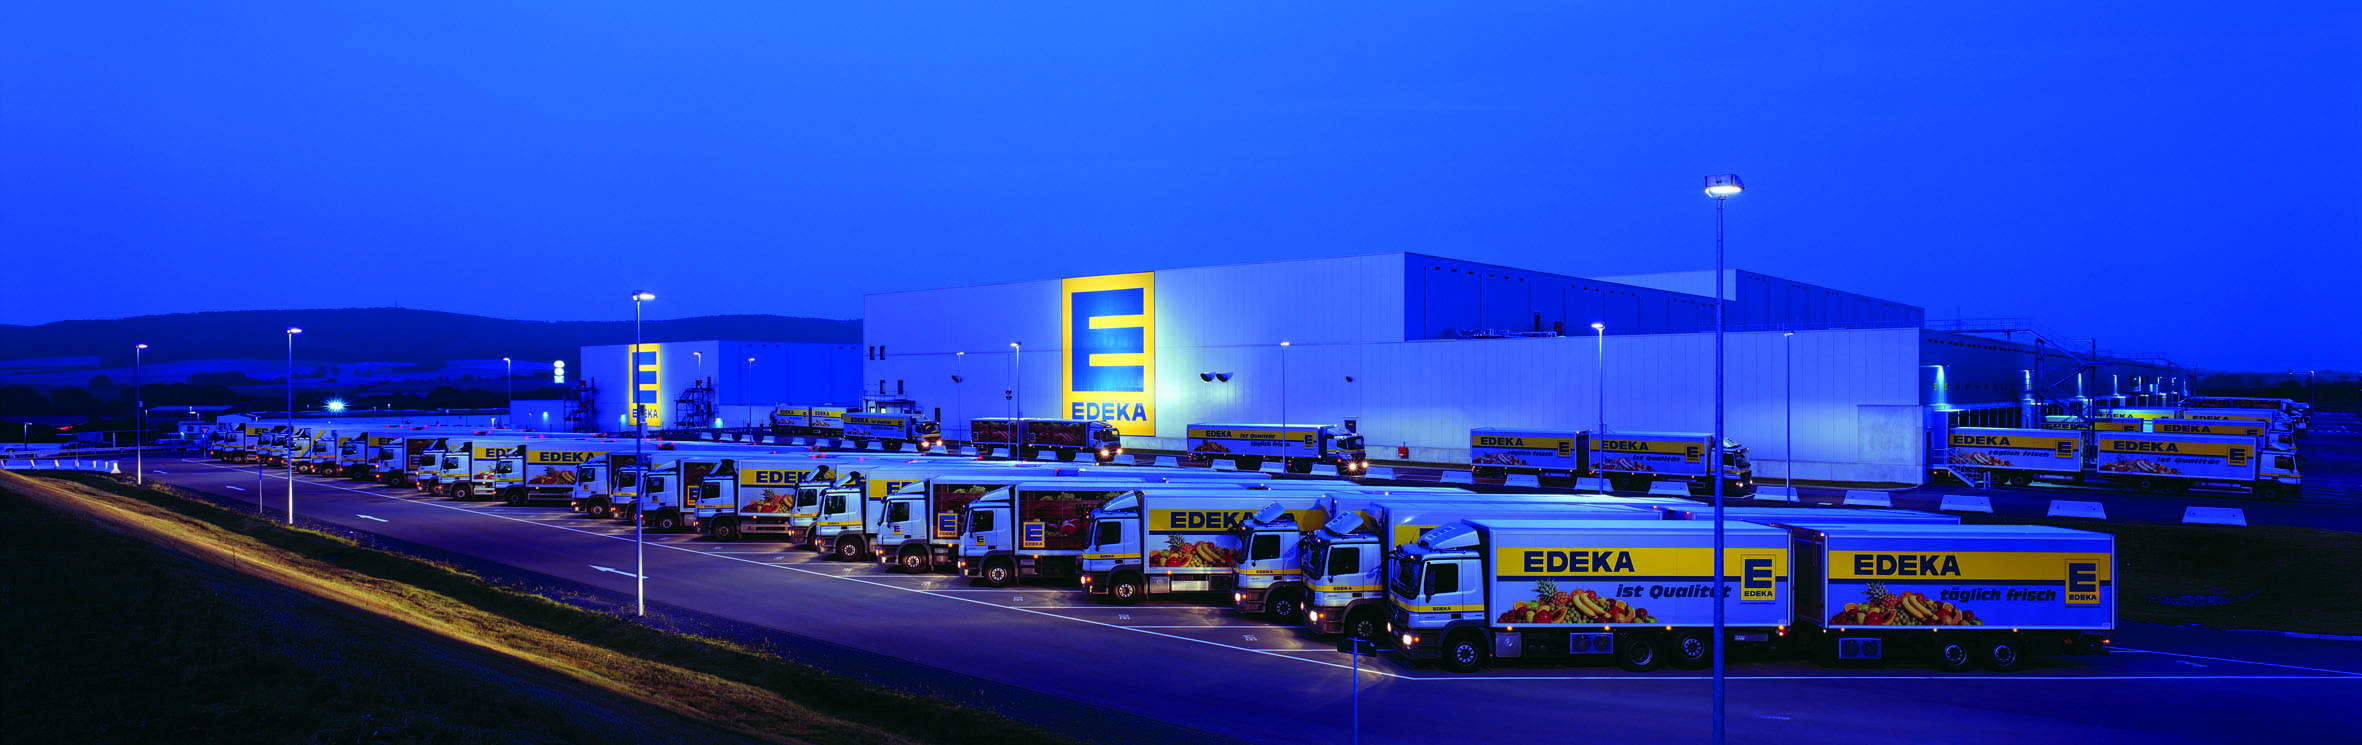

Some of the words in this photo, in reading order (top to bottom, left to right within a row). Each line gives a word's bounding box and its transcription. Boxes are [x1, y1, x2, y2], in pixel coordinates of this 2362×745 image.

[1072, 288, 1144, 391] E
[1072, 402, 1147, 421] EDEKA
[1206, 430, 1232, 438] EDEKA
[2163, 424, 2211, 433] EDEKA
[1480, 437, 1523, 446] EDEKA
[1559, 442, 1570, 452] E
[1602, 440, 1649, 450] EDEKA
[1953, 436, 2011, 446] EDEKA
[2058, 441, 2071, 453] E
[2113, 441, 2178, 452] EDEKA
[540, 452, 596, 461] EDEKA
[1686, 447, 1698, 457] E
[2230, 448, 2245, 460] E
[756, 471, 812, 483] EDEK
[940, 515, 956, 531] E
[1026, 524, 1042, 541] E
[1524, 551, 1635, 573] EDEKA
[1854, 555, 1960, 576] EDEKA
[1744, 559, 1773, 588] E
[2069, 563, 2096, 592] E
[1616, 584, 1644, 598] ist
[1940, 587, 2001, 604] täglich
[2006, 588, 2056, 602] frisch
